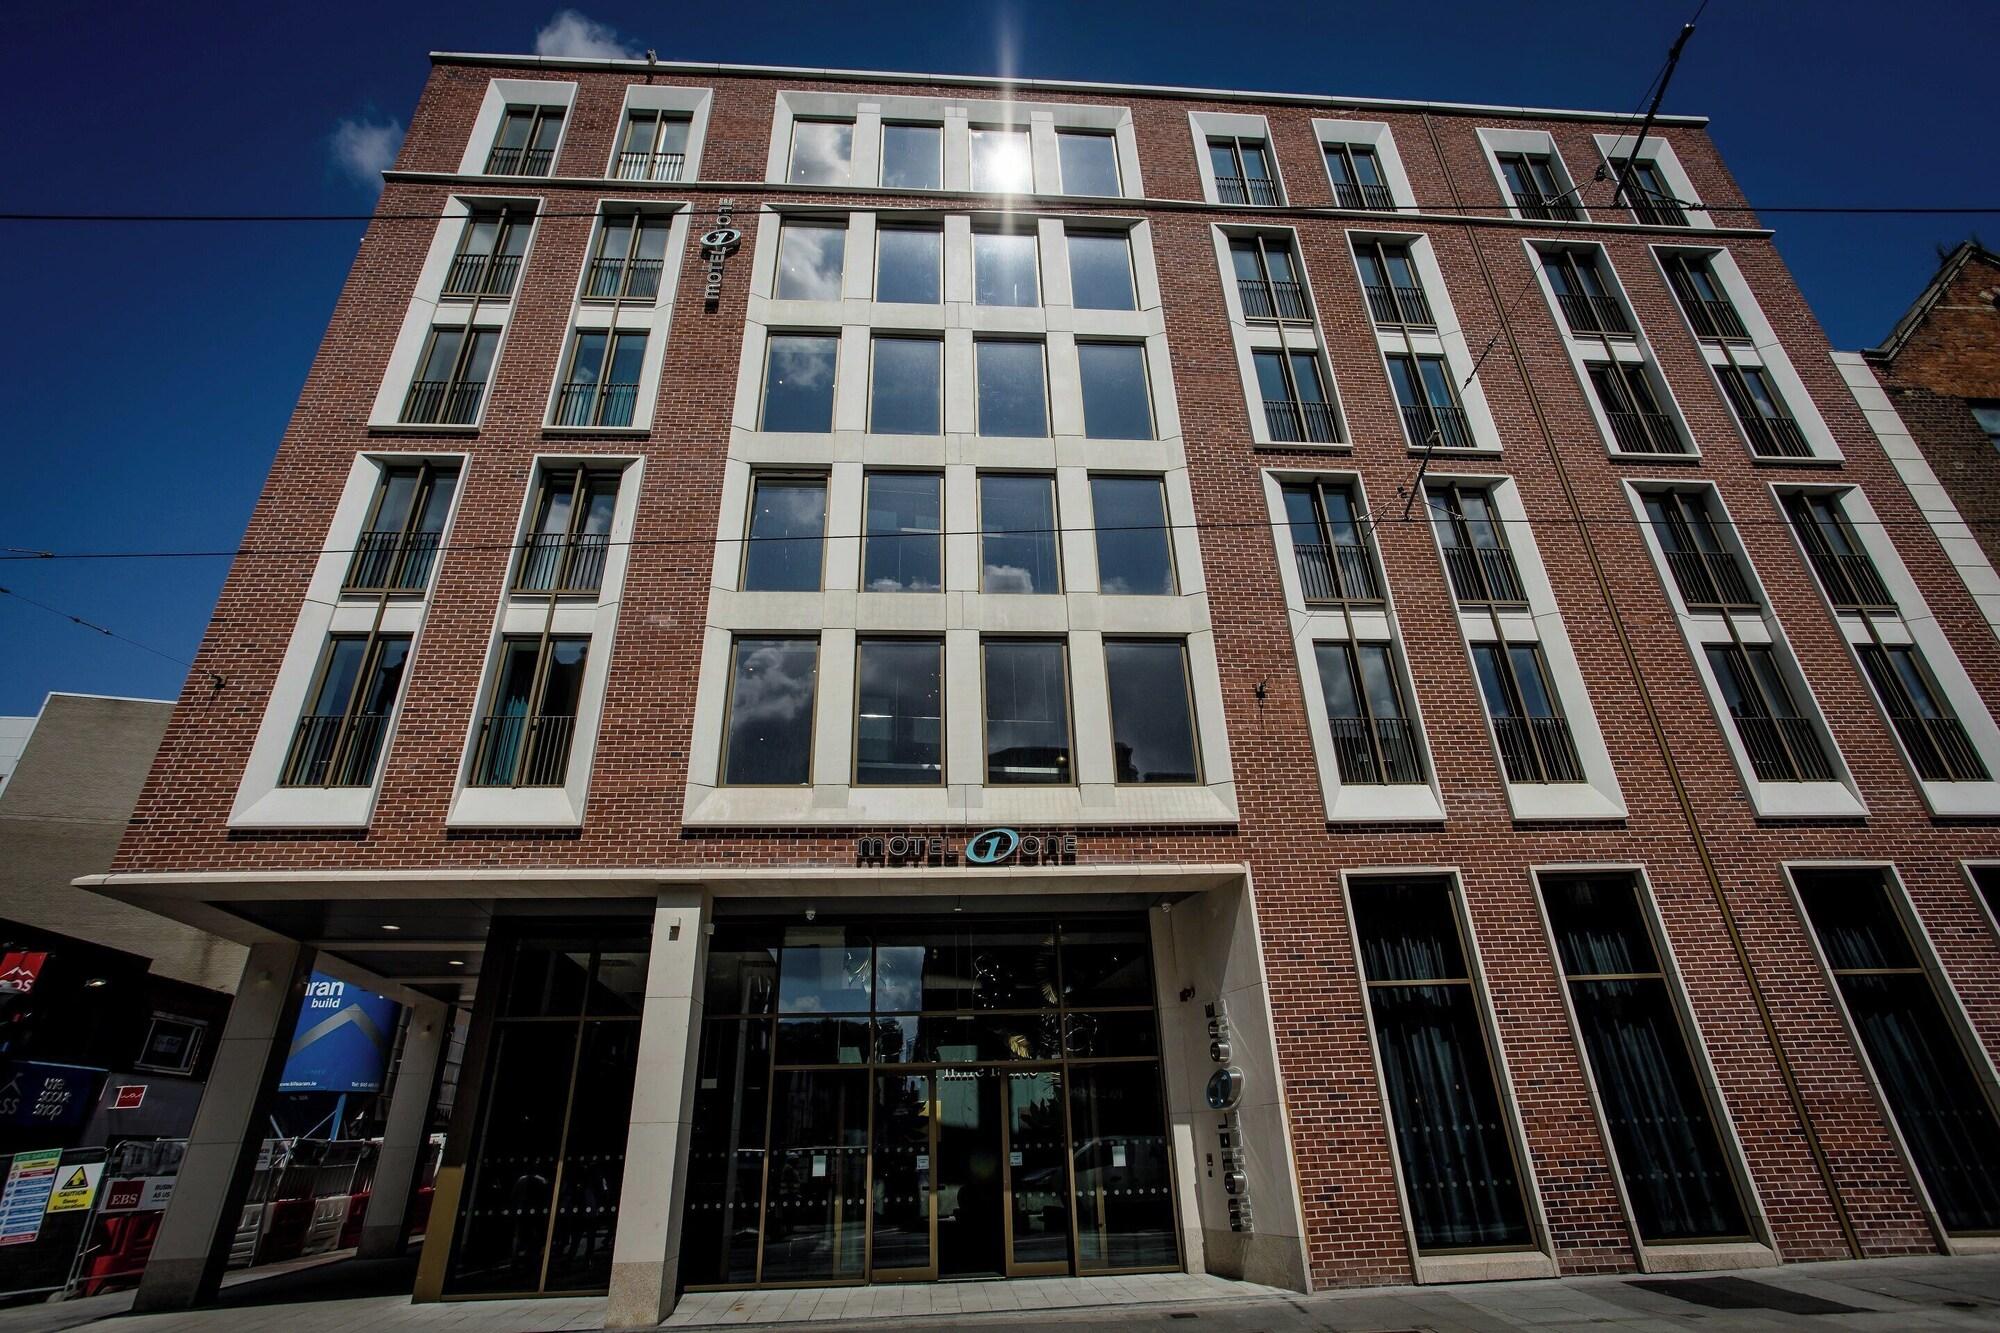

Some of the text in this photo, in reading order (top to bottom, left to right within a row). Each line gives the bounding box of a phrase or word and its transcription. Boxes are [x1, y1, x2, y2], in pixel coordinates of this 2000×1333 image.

[857, 835, 959, 856] MOTEL
[1020, 835, 1077, 855] ONE
[310, 998, 341, 1008] build
[58, 1190, 88, 1198] CAUTION
[110, 1193, 139, 1206] EBS
